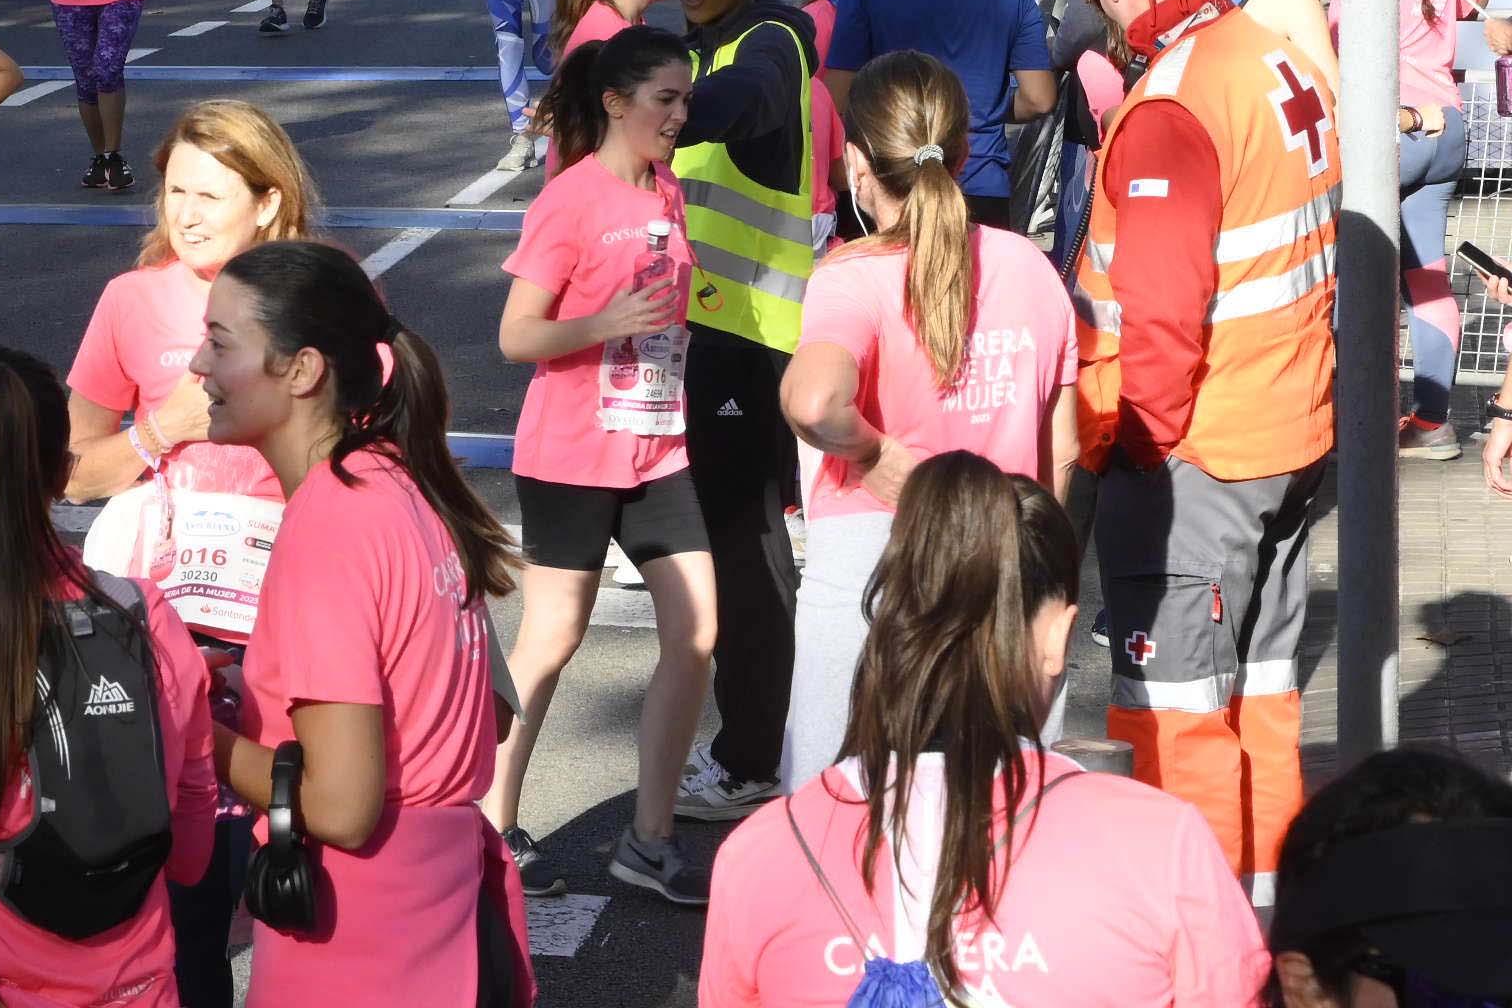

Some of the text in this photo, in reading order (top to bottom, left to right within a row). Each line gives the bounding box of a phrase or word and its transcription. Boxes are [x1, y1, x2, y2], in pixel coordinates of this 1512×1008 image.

[983, 358, 1014, 382] LA
[716, 407, 743, 417] adidas
[180, 569, 219, 583] 30230
[181, 586, 191, 595] DE
[193, 586, 205, 595] LA
[206, 588, 237, 600] MUJER
[84, 701, 136, 716] AONIJIE
